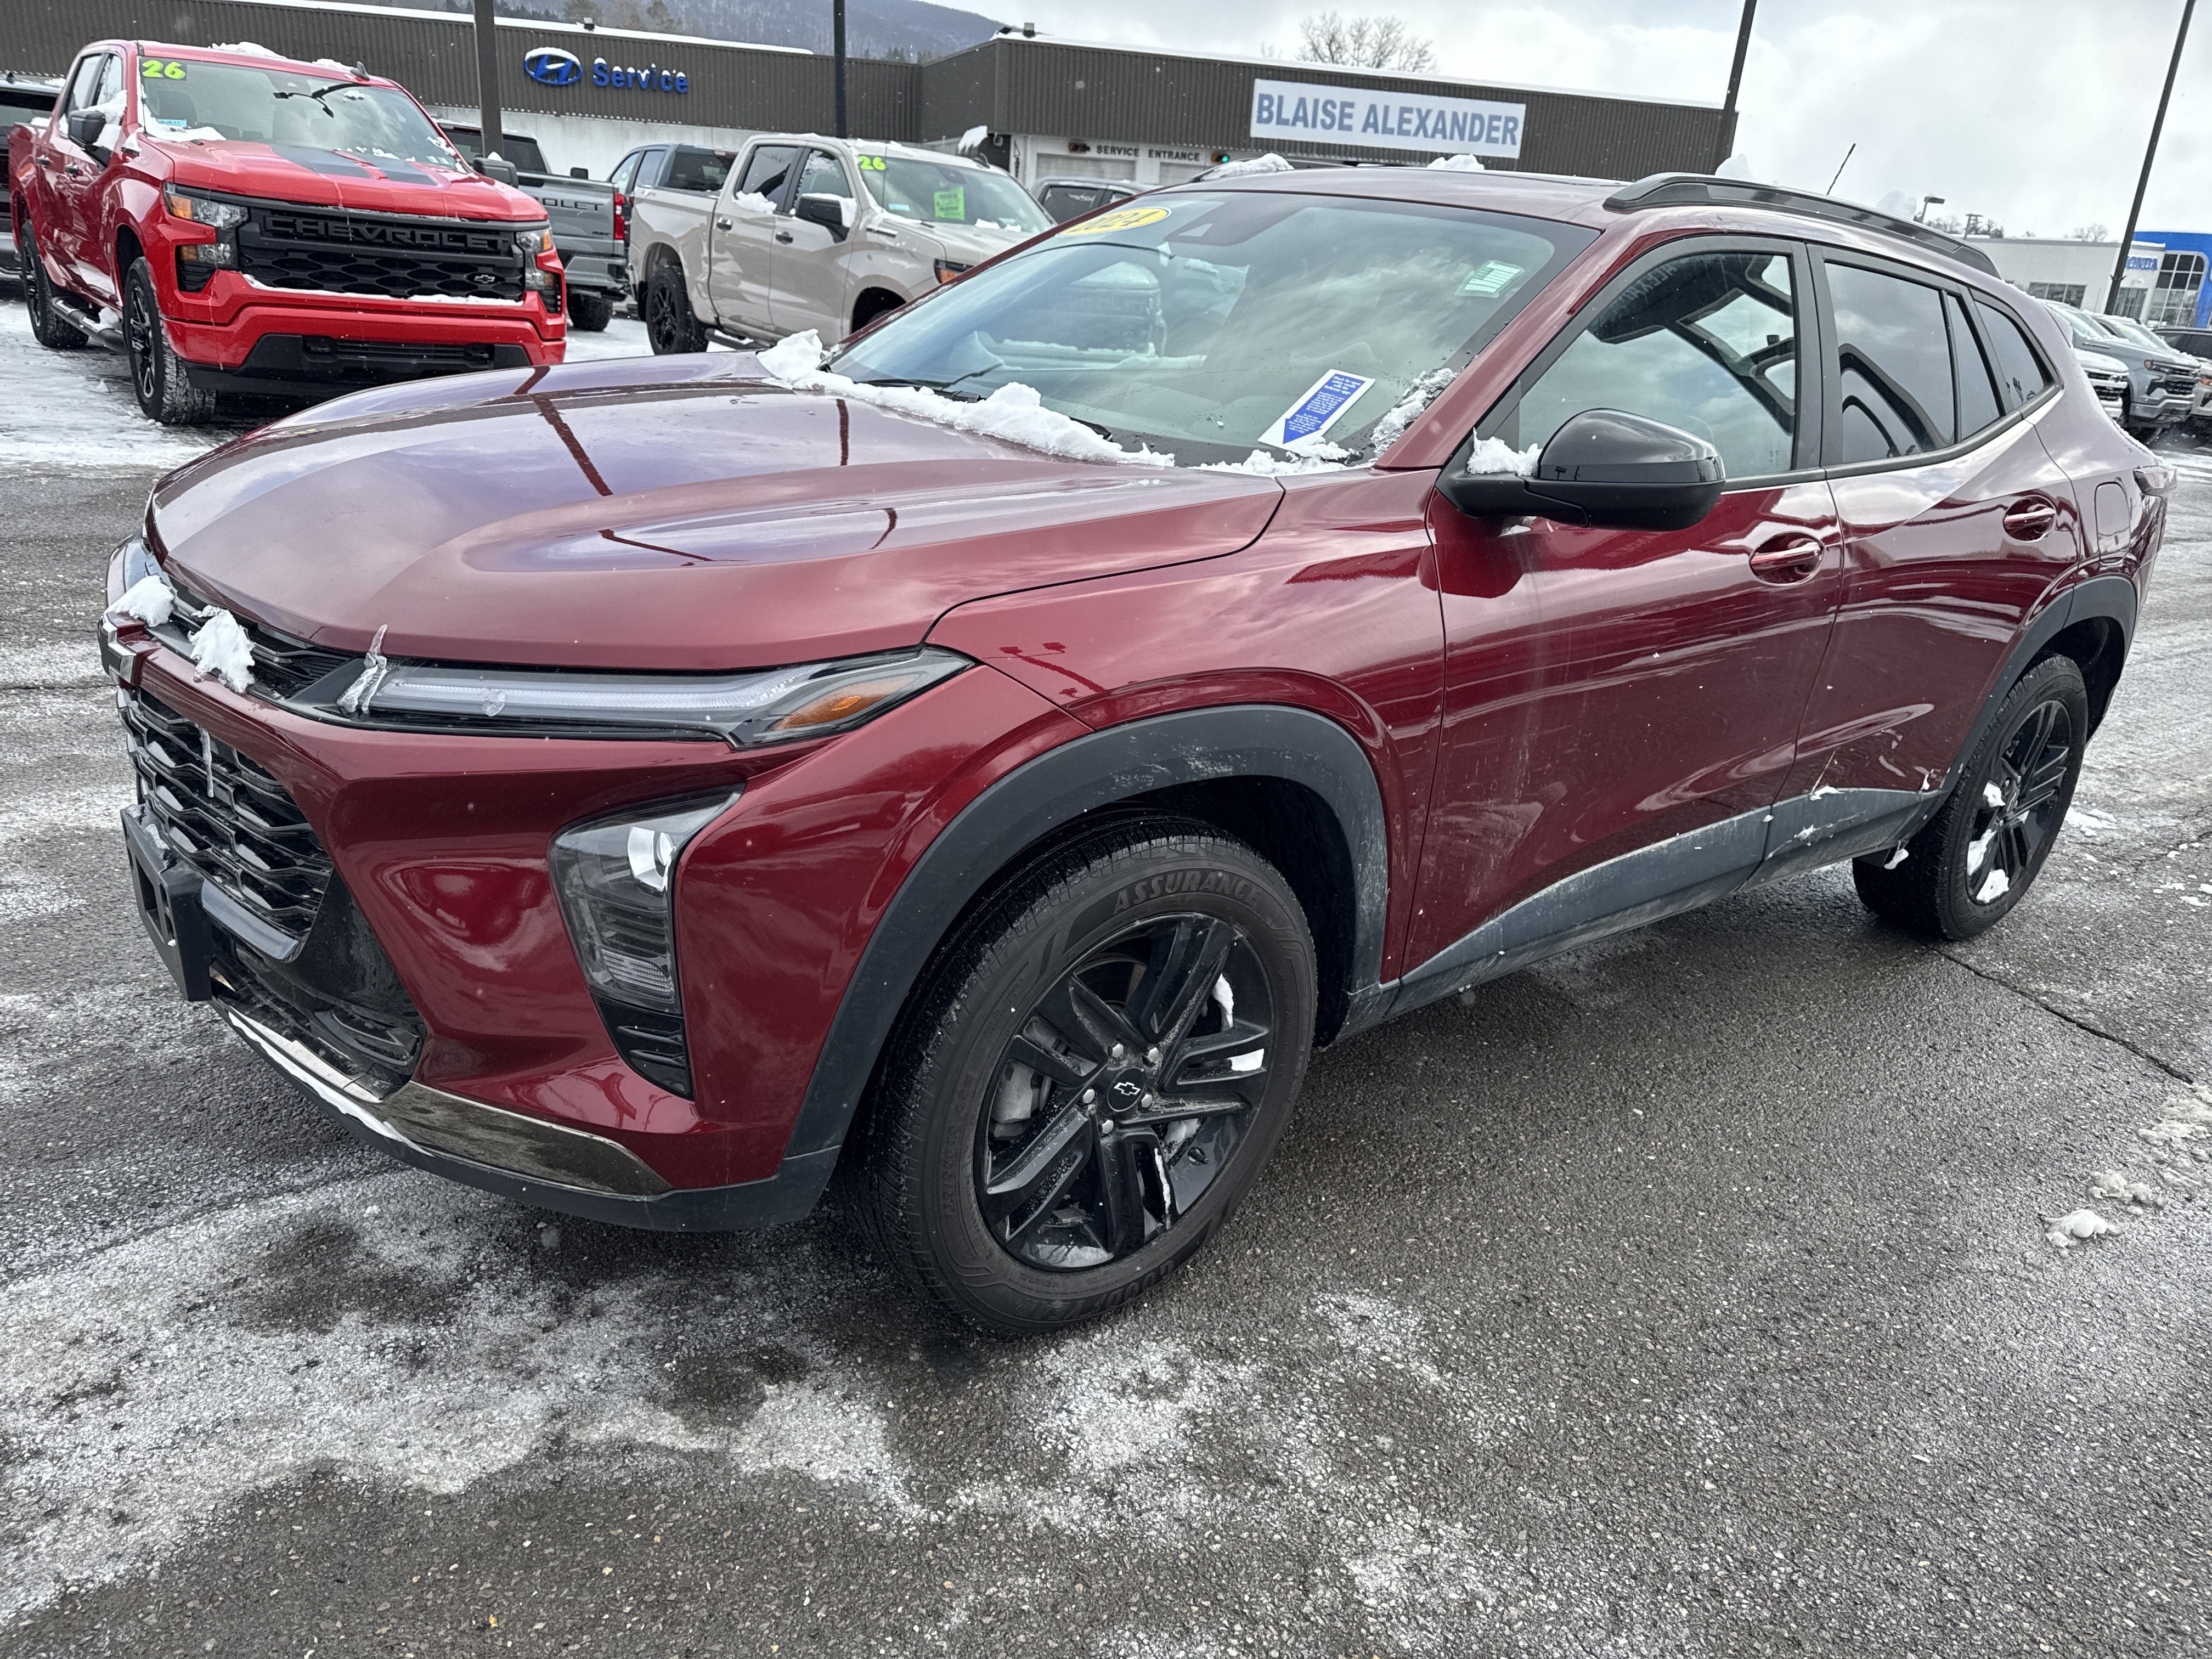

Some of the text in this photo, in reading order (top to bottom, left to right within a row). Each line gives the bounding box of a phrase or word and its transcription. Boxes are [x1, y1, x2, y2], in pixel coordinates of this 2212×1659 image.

[142, 60, 185, 79] 26
[592, 59, 689, 93] Service
[1256, 93, 1519, 146] BLAISE ALEXANDER
[858, 156, 887, 171] 26
[1097, 145, 1200, 161] SERVICE ENTRANCE
[534, 197, 603, 211] OLET
[265, 216, 508, 252] CHEVROLET
[1114, 870, 1262, 915] ASSURANCE
